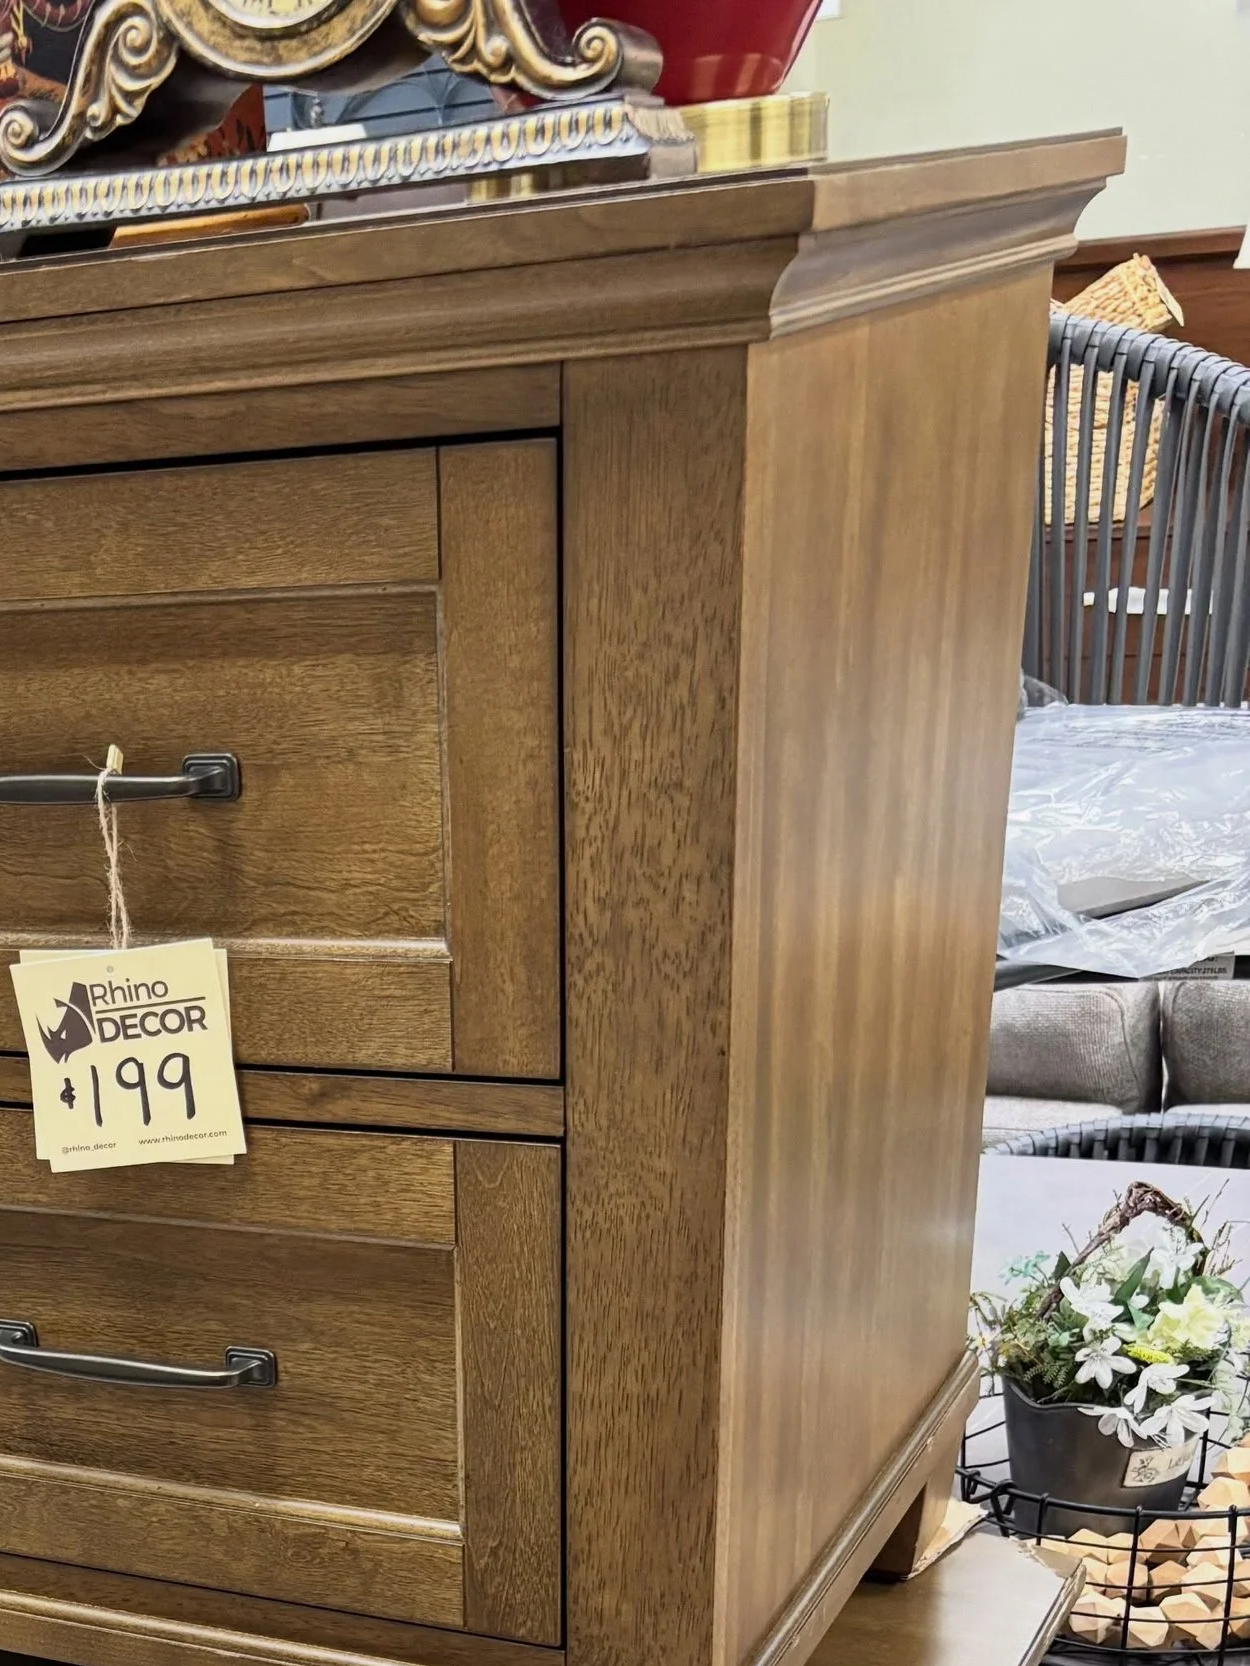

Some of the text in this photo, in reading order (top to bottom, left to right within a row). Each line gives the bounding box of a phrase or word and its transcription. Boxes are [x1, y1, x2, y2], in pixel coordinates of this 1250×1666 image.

[89, 977, 169, 1007] Rhino
[96, 1005, 208, 1043] DECOR
[59, 1052, 196, 1127] $199
[61, 1141, 117, 1154] @rhino_decor
[138, 1129, 228, 1146] www.rhinodecor.com
